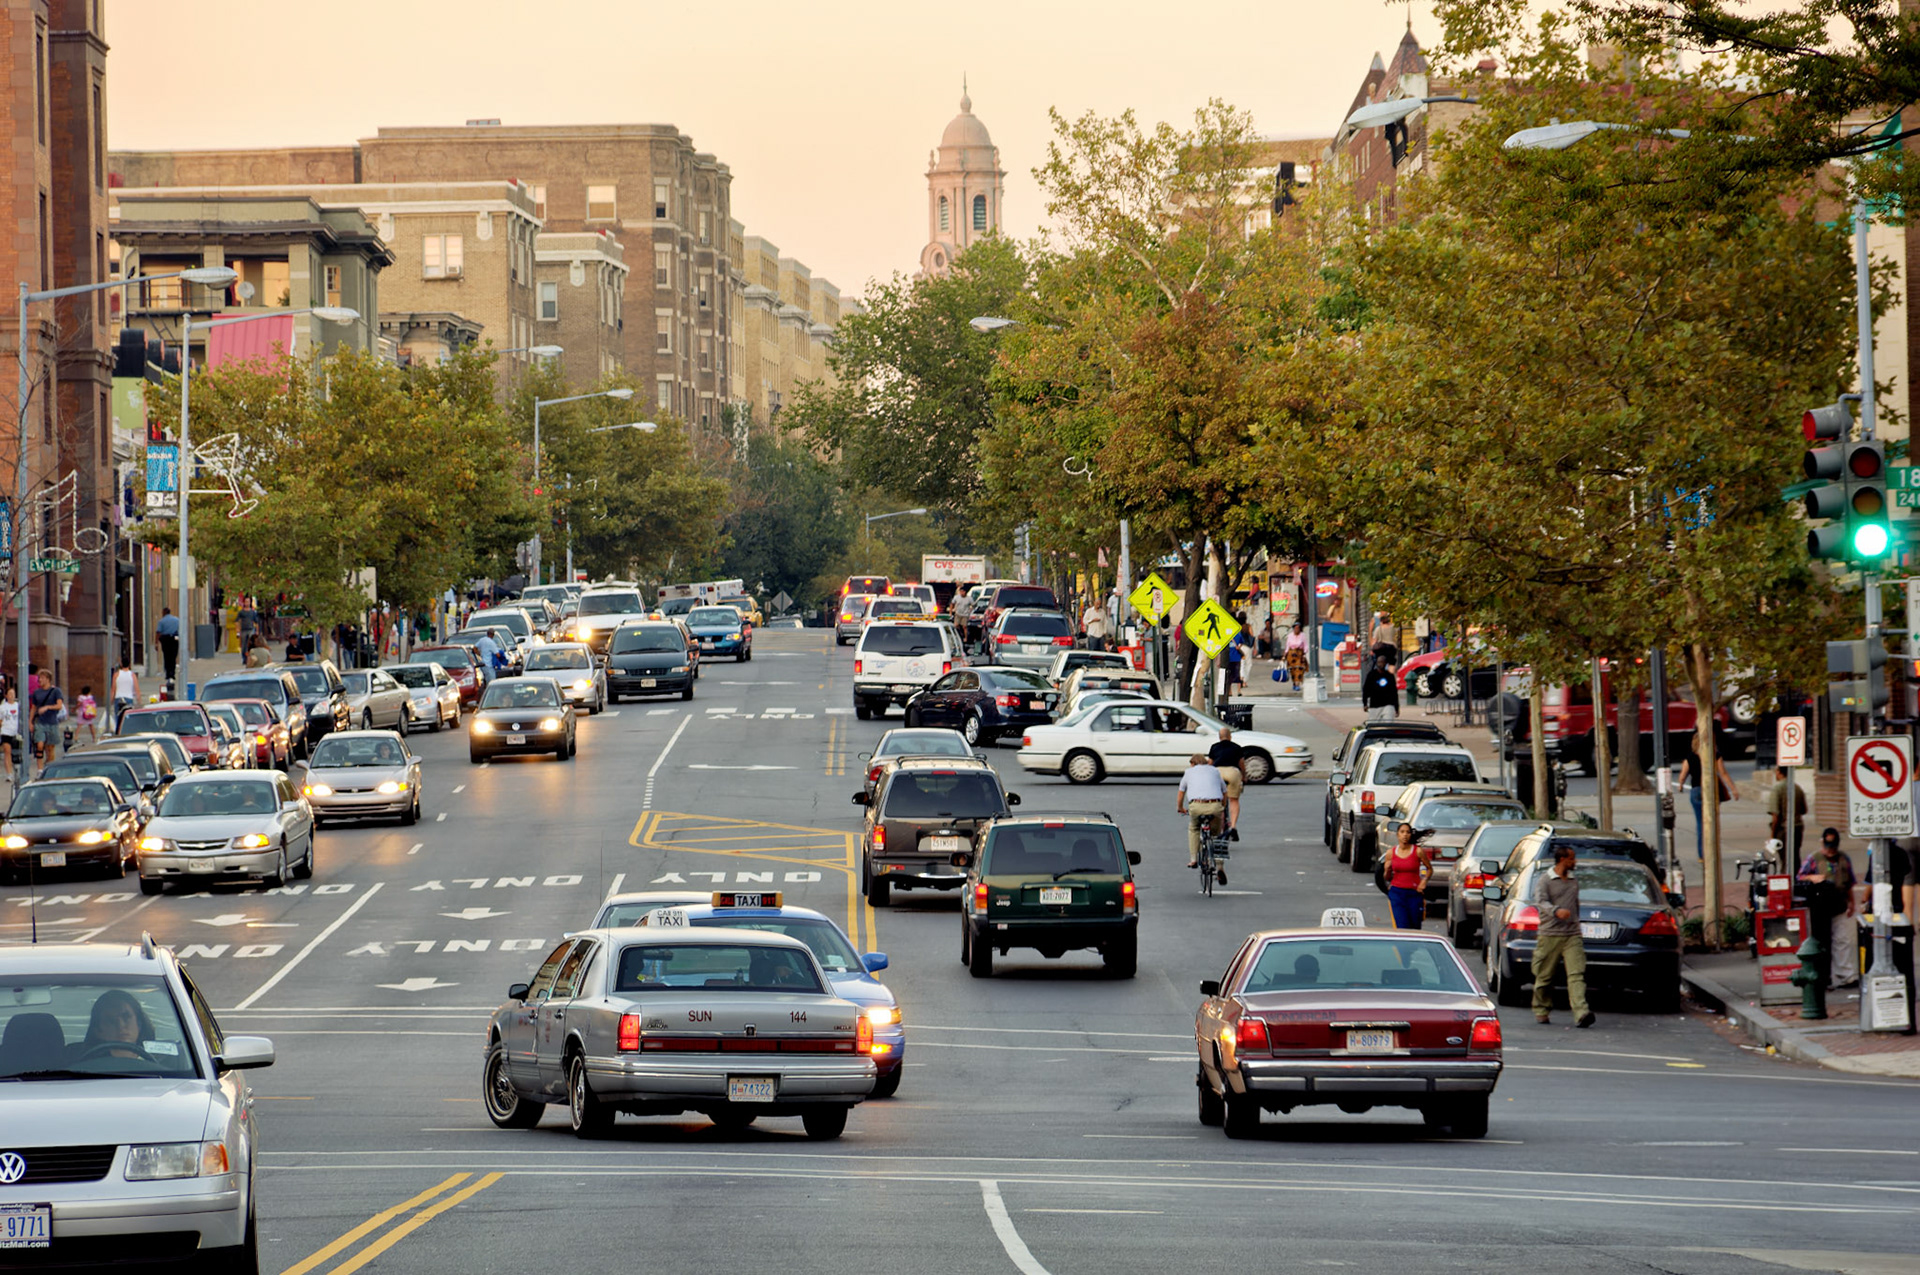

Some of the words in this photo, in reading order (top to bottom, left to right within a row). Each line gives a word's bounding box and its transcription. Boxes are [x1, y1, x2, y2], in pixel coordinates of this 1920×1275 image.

[934, 561, 974, 569] CVS.com
[409, 875, 583, 891] ONLY
[651, 871, 822, 883] ONLY
[736, 895, 760, 907] TAXI
[657, 917, 683, 926] TAXI
[1331, 917, 1357, 926] TAXI
[345, 939, 546, 956] ONLY
[688, 1010, 712, 1022] SUN
[789, 1011, 807, 1023] 144
[8, 1215, 45, 1237] 9771
